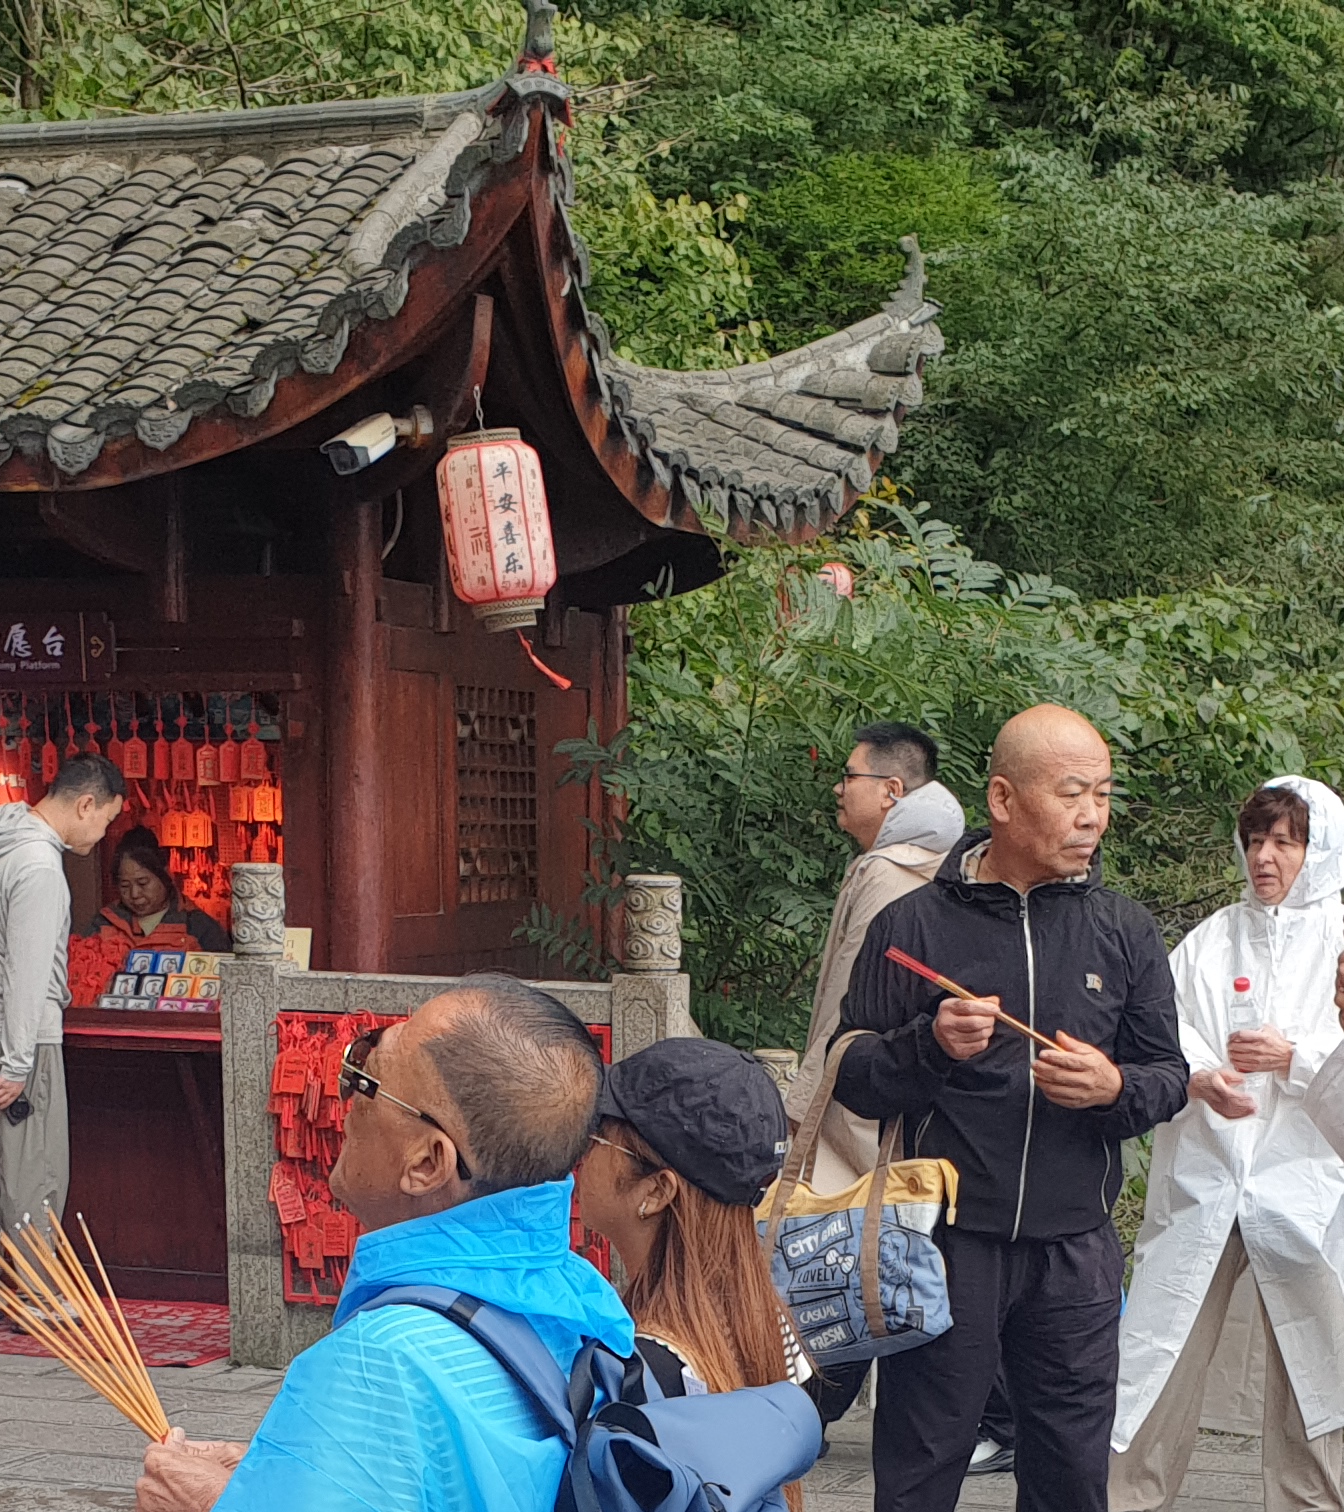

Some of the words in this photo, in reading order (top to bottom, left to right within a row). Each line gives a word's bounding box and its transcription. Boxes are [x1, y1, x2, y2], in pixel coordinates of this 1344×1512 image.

[492, 460, 524, 575] 平安喜乐
[20, 660, 61, 670] Platform
[787, 1235, 819, 1258] CITY
[821, 1219, 847, 1243] GIRL
[797, 1267, 838, 1284] LOVELY
[799, 1304, 840, 1324] CASUAL
[809, 1325, 847, 1350] FRESH
